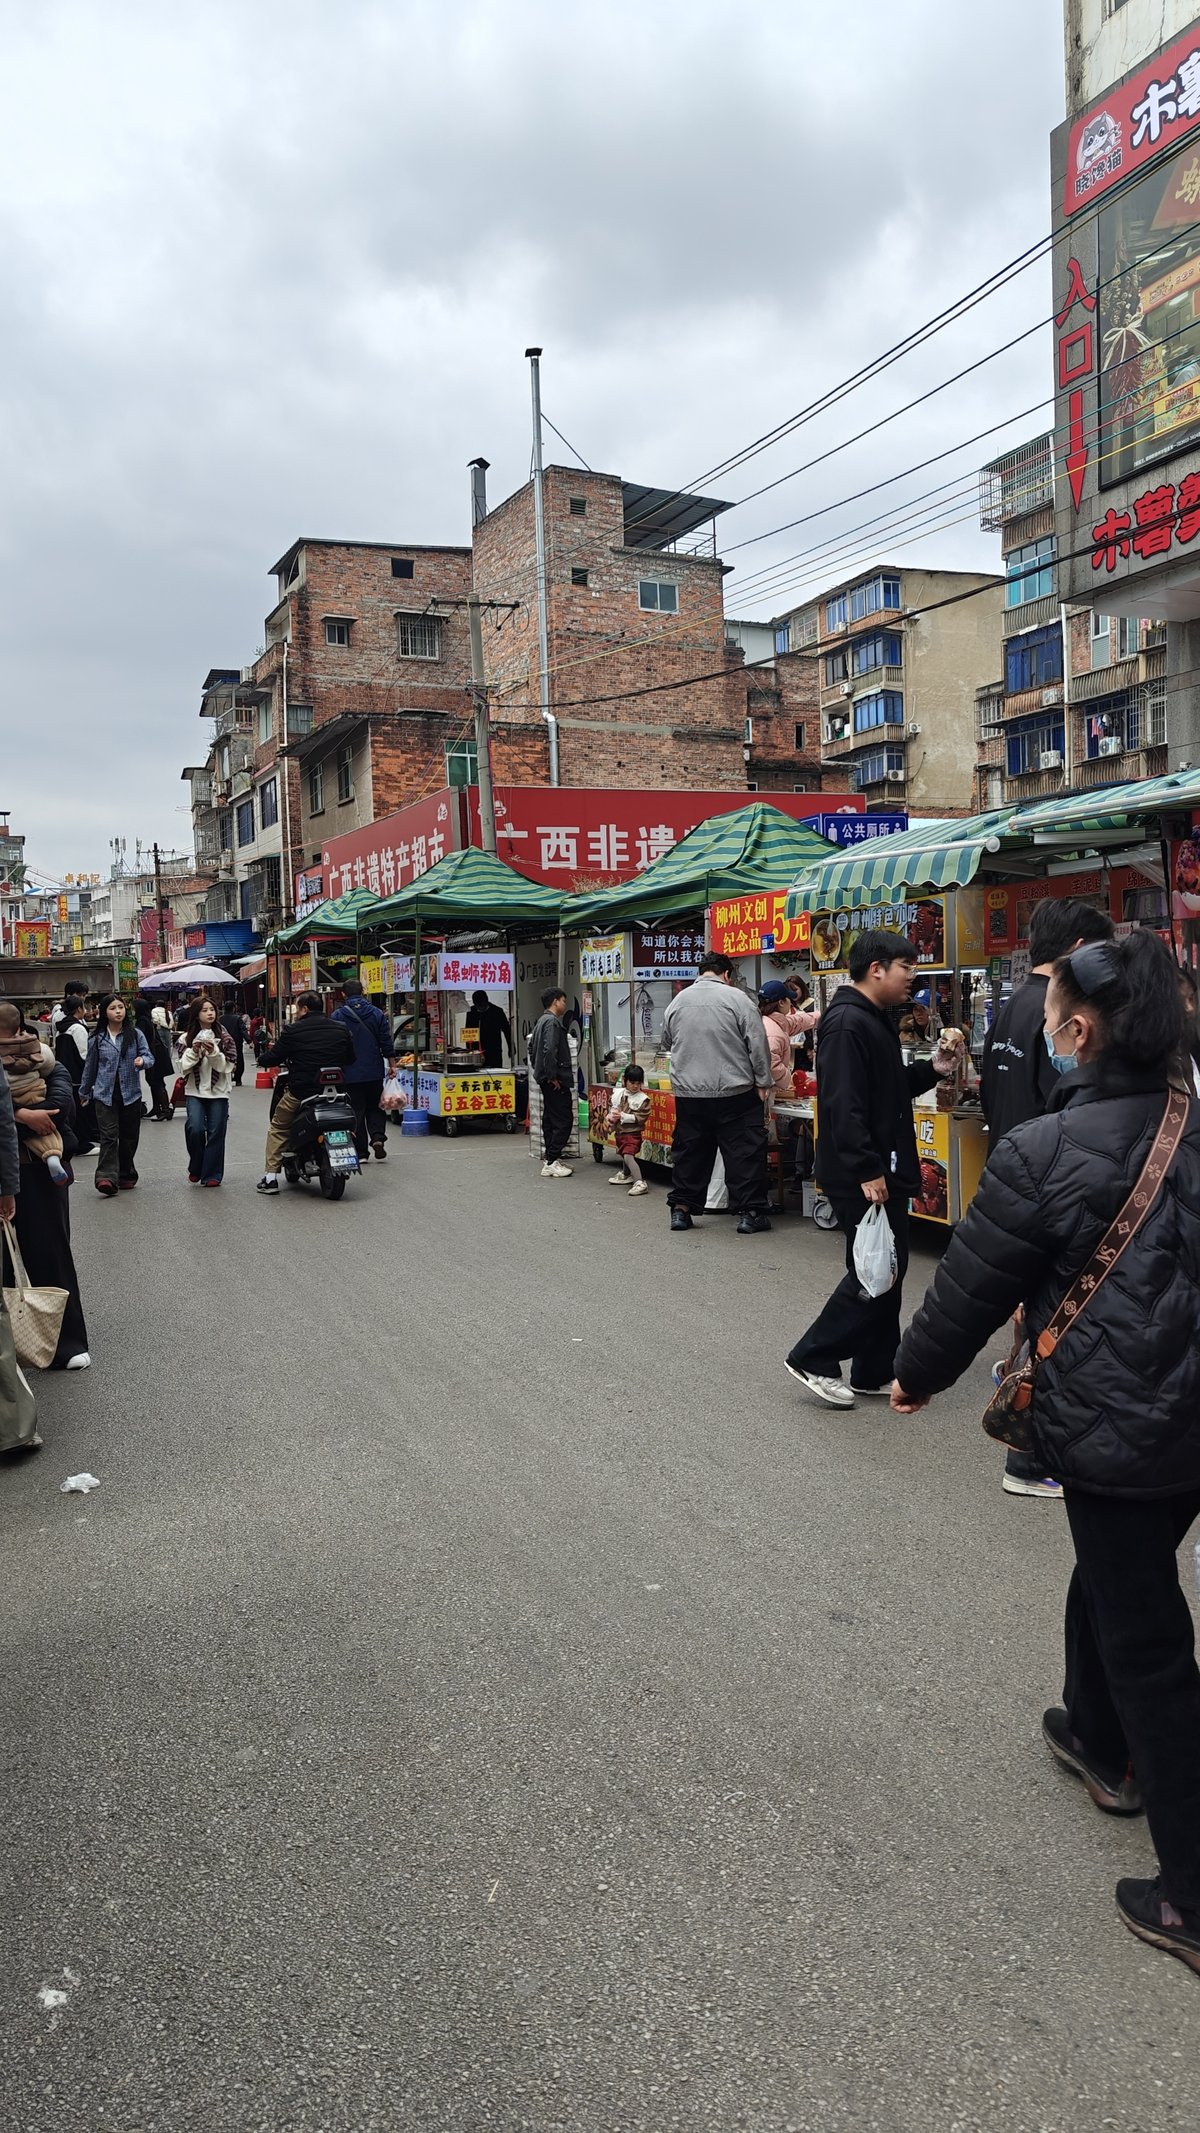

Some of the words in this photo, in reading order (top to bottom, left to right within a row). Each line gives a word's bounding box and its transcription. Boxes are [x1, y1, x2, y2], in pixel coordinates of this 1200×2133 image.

[1075, 148, 1122, 197] 晓馋猫
[1055, 257, 1097, 389] 入口
[842, 823, 889, 838] 公共厕所
[329, 828, 444, 900] 广西非遗特产超市
[716, 897, 767, 929] 柳州文创
[850, 903, 918, 930] 柳州特色小吃
[641, 934, 705, 948] 知道你会来
[723, 927, 761, 953] 纪念品
[654, 950, 705, 963] 所以我在
[443, 960, 512, 985] 螺蛳粉角
[526, 960, 576, 979] 广西北部湾行
[917, 989, 926, 998] B
[460, 1079, 503, 1093] 青云首家
[455, 1093, 513, 1112] 五谷豆花
